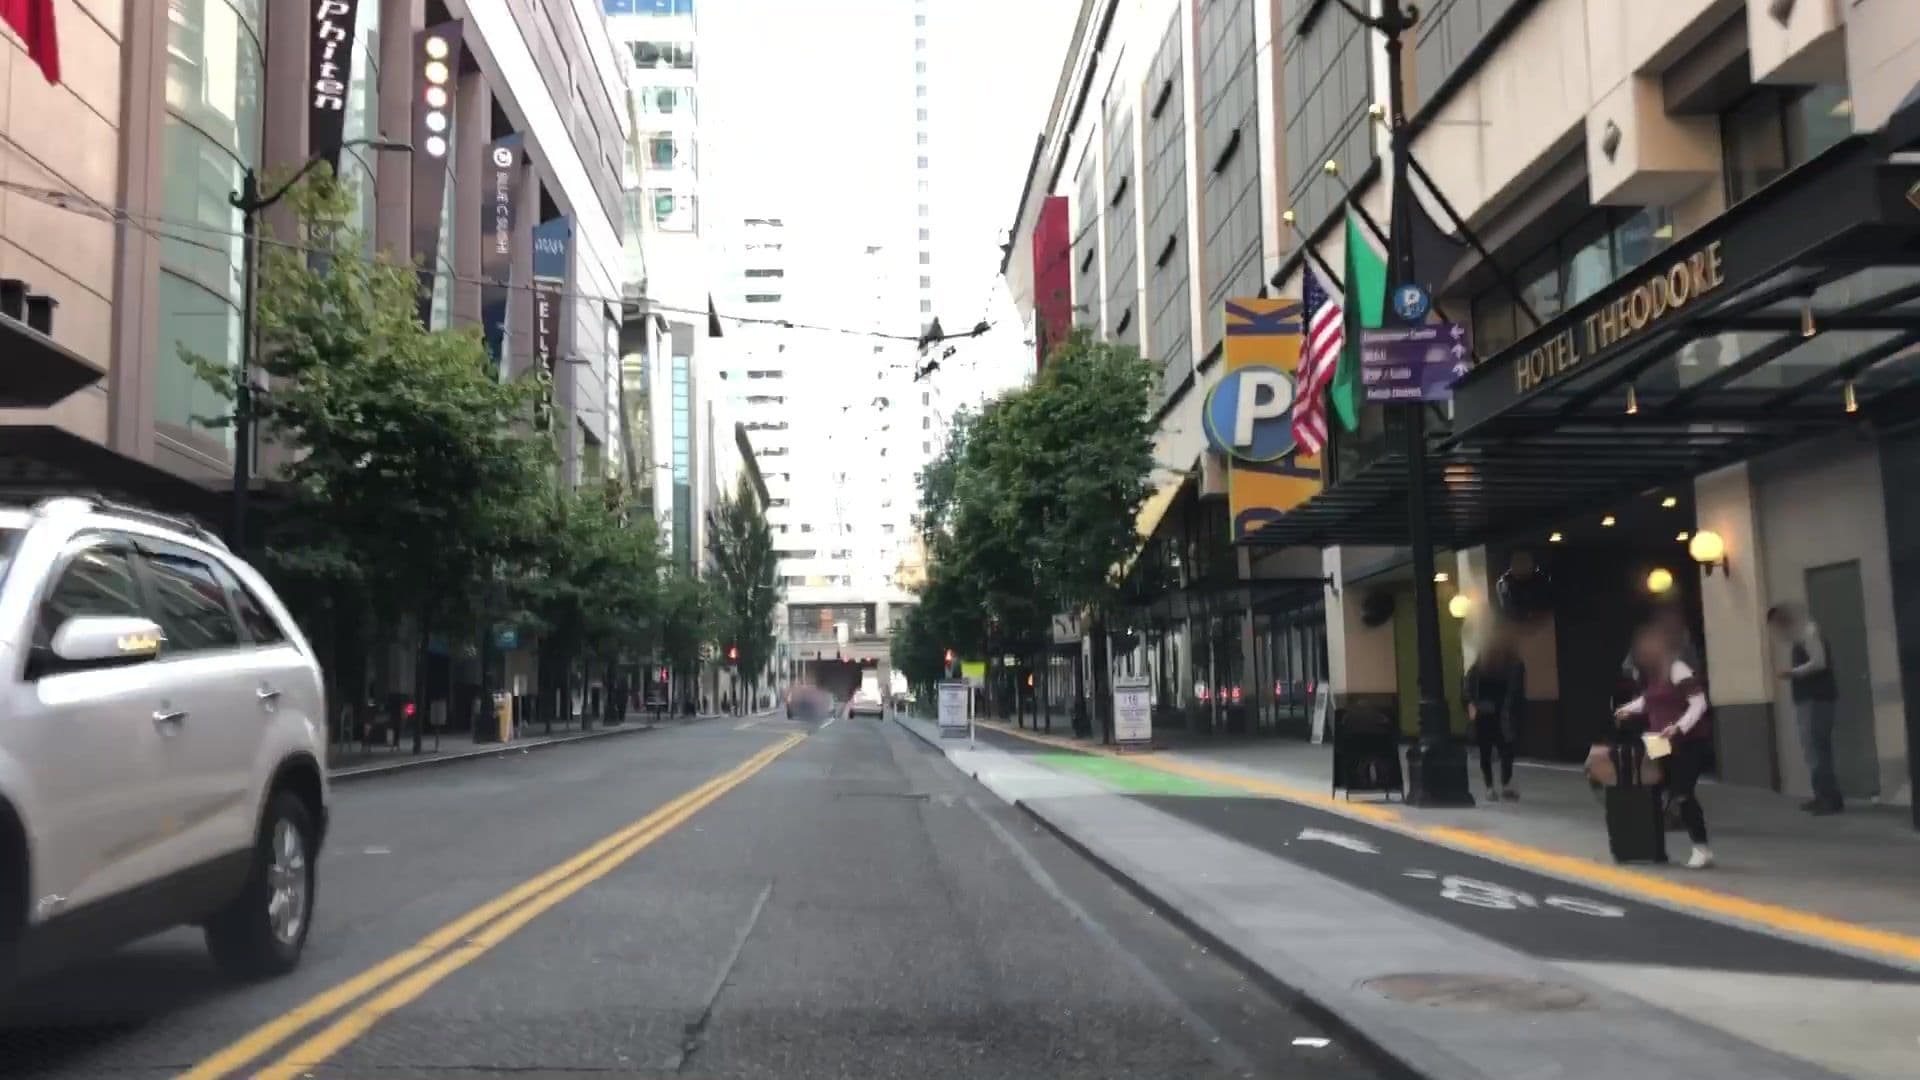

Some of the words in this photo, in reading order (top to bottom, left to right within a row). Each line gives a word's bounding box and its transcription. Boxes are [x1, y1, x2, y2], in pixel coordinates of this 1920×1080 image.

[1516, 327, 1580, 394] HOTEL
[1585, 240, 1725, 354] THEODORE
[1234, 370, 1293, 446] P
